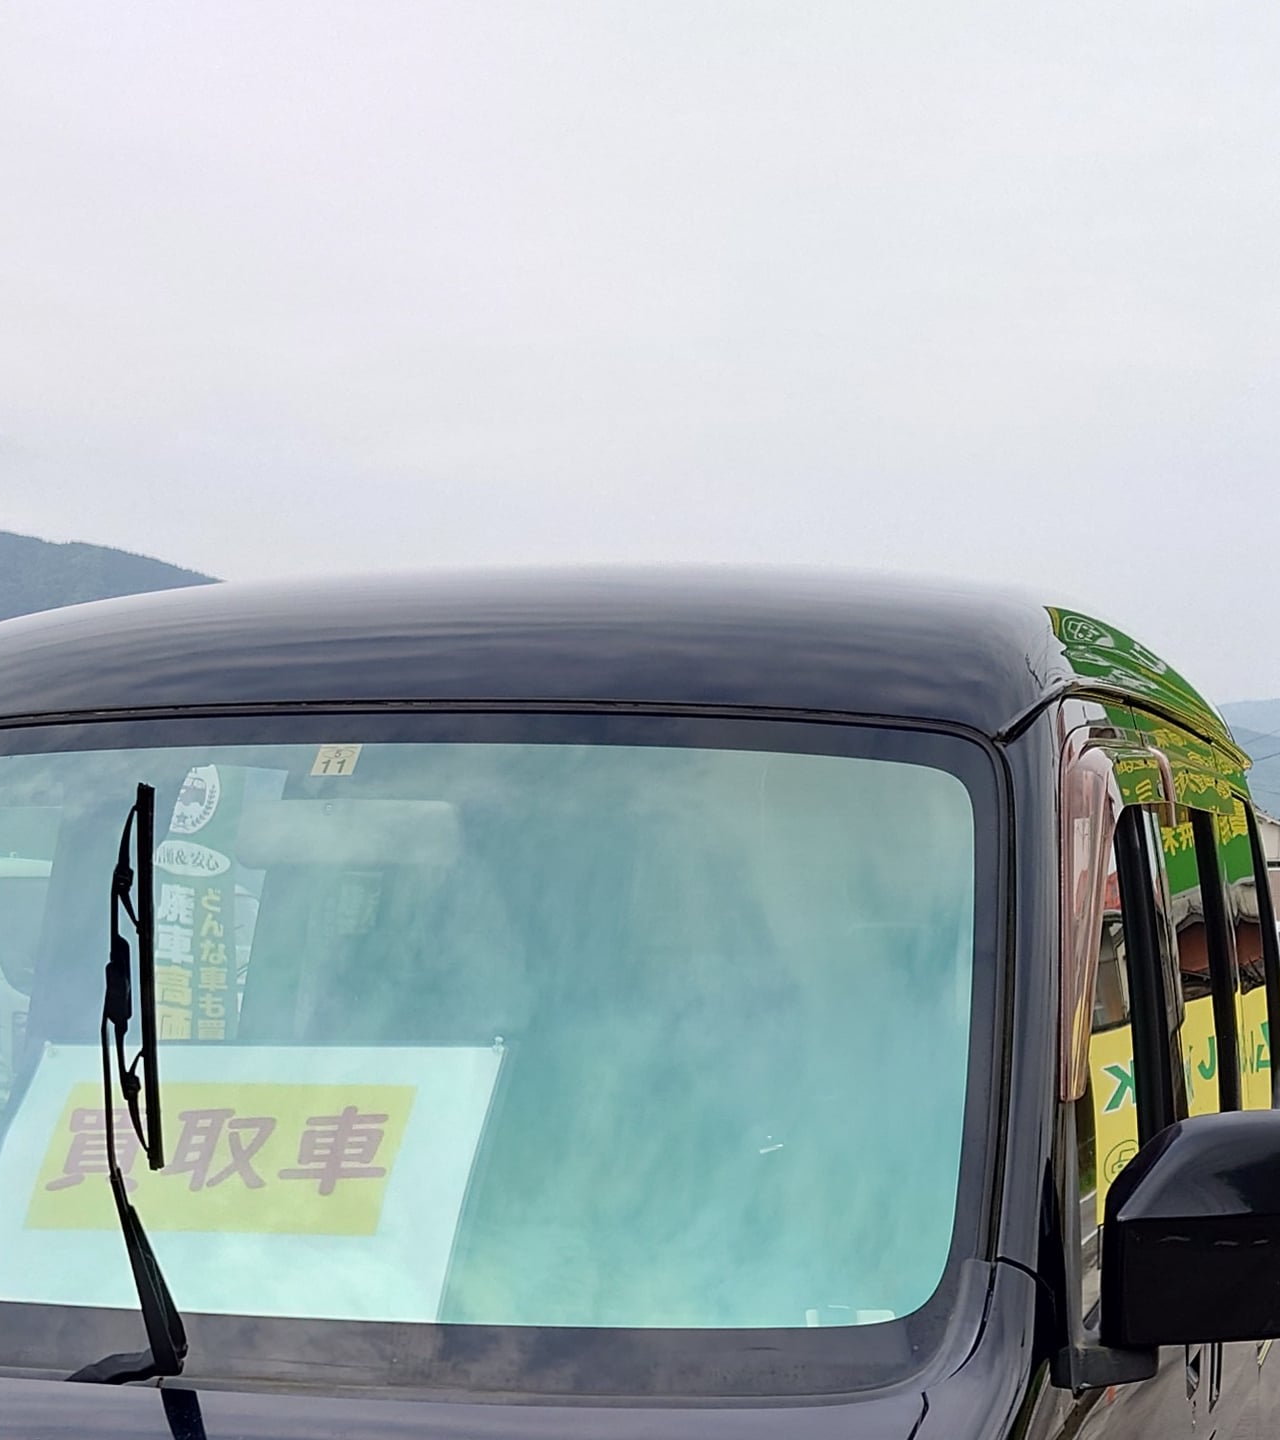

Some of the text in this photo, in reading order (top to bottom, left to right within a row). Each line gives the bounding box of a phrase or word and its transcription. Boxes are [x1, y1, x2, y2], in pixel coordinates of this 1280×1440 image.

[322, 759, 347, 774] 11
[45, 1106, 390, 1196] 買取車
